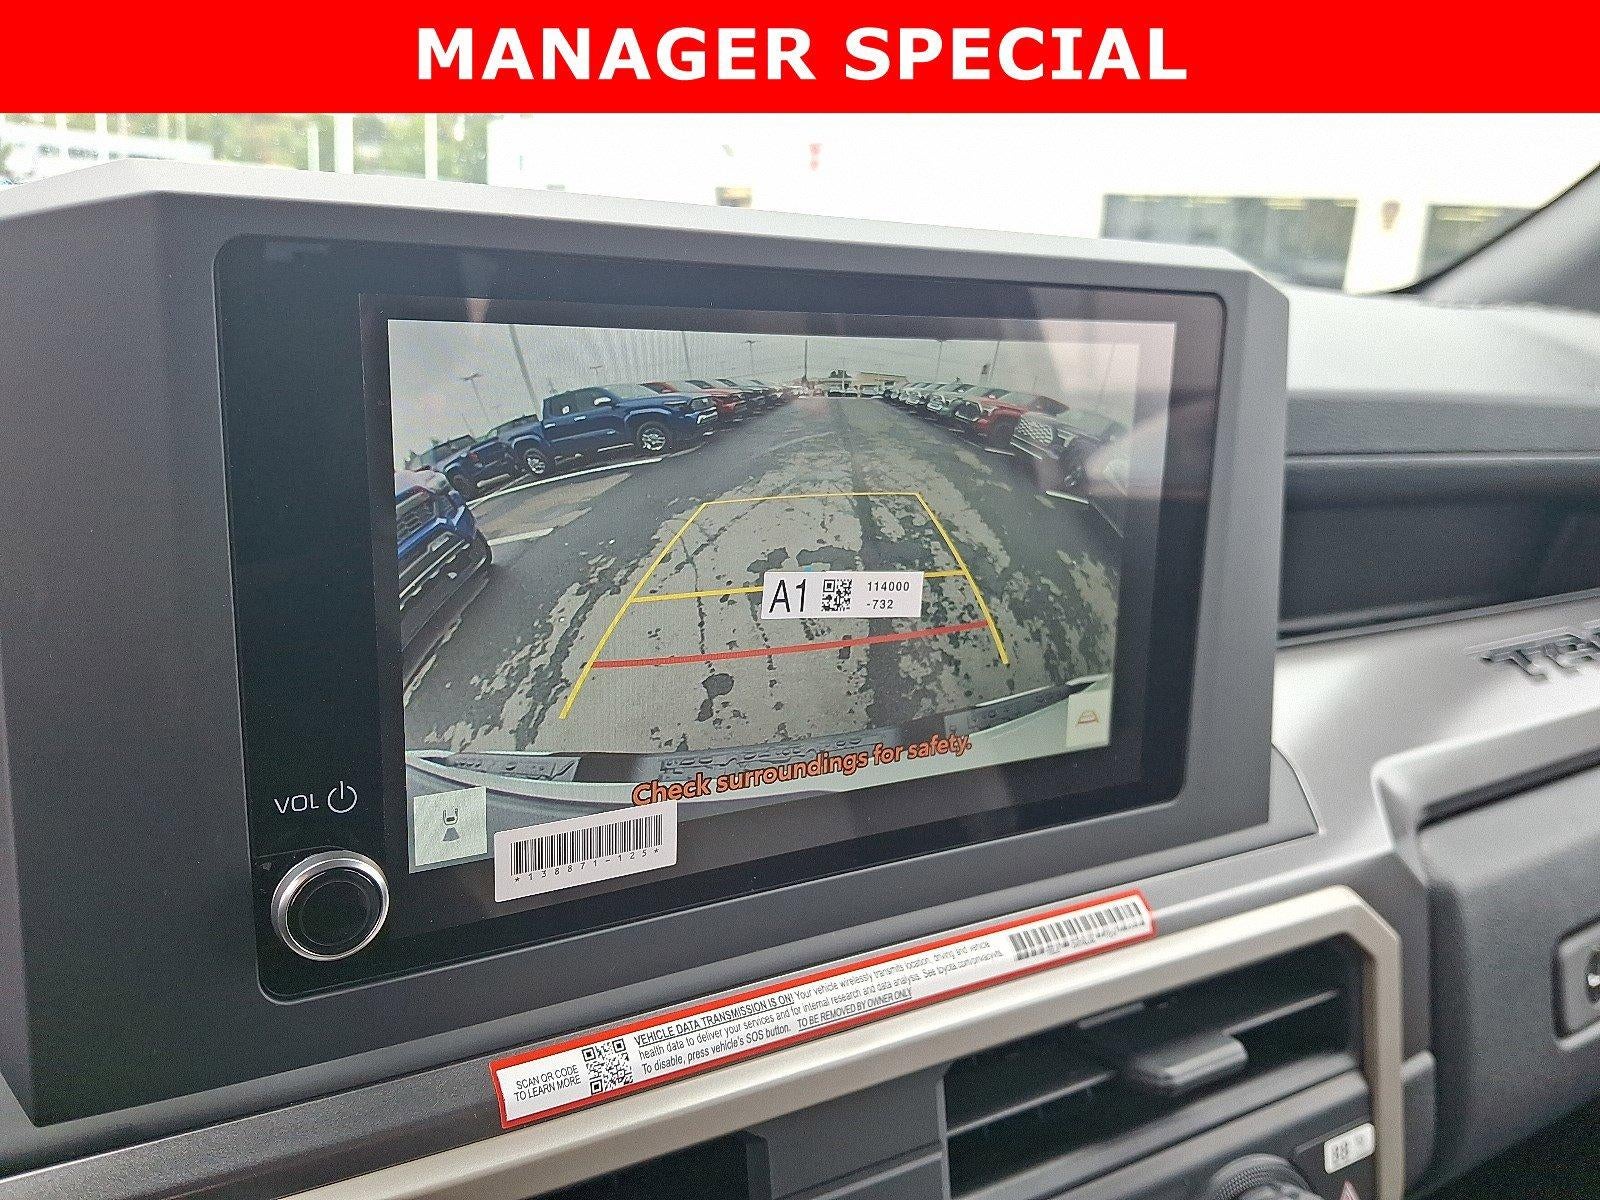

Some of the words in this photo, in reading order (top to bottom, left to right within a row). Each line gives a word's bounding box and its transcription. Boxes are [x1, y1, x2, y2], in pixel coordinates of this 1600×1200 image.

[769, 579, 806, 613] A1
[867, 581, 910, 592] 114000
[866, 599, 894, 610] -732
[632, 772, 711, 806] Check
[715, 748, 869, 793] surroundings
[872, 740, 903, 766] for
[906, 733, 972, 760] safety.
[274, 794, 319, 813] VOL
[633, 1026, 673, 1046] VEHICLE
[676, 1019, 701, 1034] DATA
[700, 1000, 767, 1027] TRANSMISSION
[768, 997, 777, 1008] IS
[794, 989, 812, 1001] Your
[813, 981, 839, 996] vehicle
[840, 973, 873, 987] wirelessly
[873, 963, 903, 977] transmits
[638, 1045, 665, 1061] health
[666, 1038, 685, 1053] data
[685, 1036, 695, 1046] to
[696, 1029, 723, 1043] deliver
[724, 1025, 742, 1038] your
[743, 1014, 775, 1031] services
[776, 1009, 790, 1021] and
[791, 1006, 802, 1016] for
[803, 998, 829, 1013] internal
[831, 989, 861, 1004] research
[862, 985, 876, 996] and
[877, 980, 892, 992] data
[922, 968, 937, 979] See
[641, 1063, 652, 1075] To
[654, 1053, 686, 1071] disable,
[687, 1047, 710, 1064] press
[710, 1036, 745, 1054] vehicle's
[746, 1029, 764, 1044] SOS
[765, 1022, 791, 1038] button.
[797, 1018, 808, 1029] TO
[809, 1014, 819, 1024] BE
[820, 1003, 856, 1020] REMOVED
[856, 1001, 867, 1010] BY
[867, 993, 894, 1007] OWNER
[894, 987, 912, 1000] ONLY
[513, 1090, 526, 1102] TO
[527, 1082, 556, 1099] LEARN
[557, 1075, 582, 1090] MORE
[516, 1076, 540, 1090] SCAN
[554, 1064, 578, 1077] CODE
